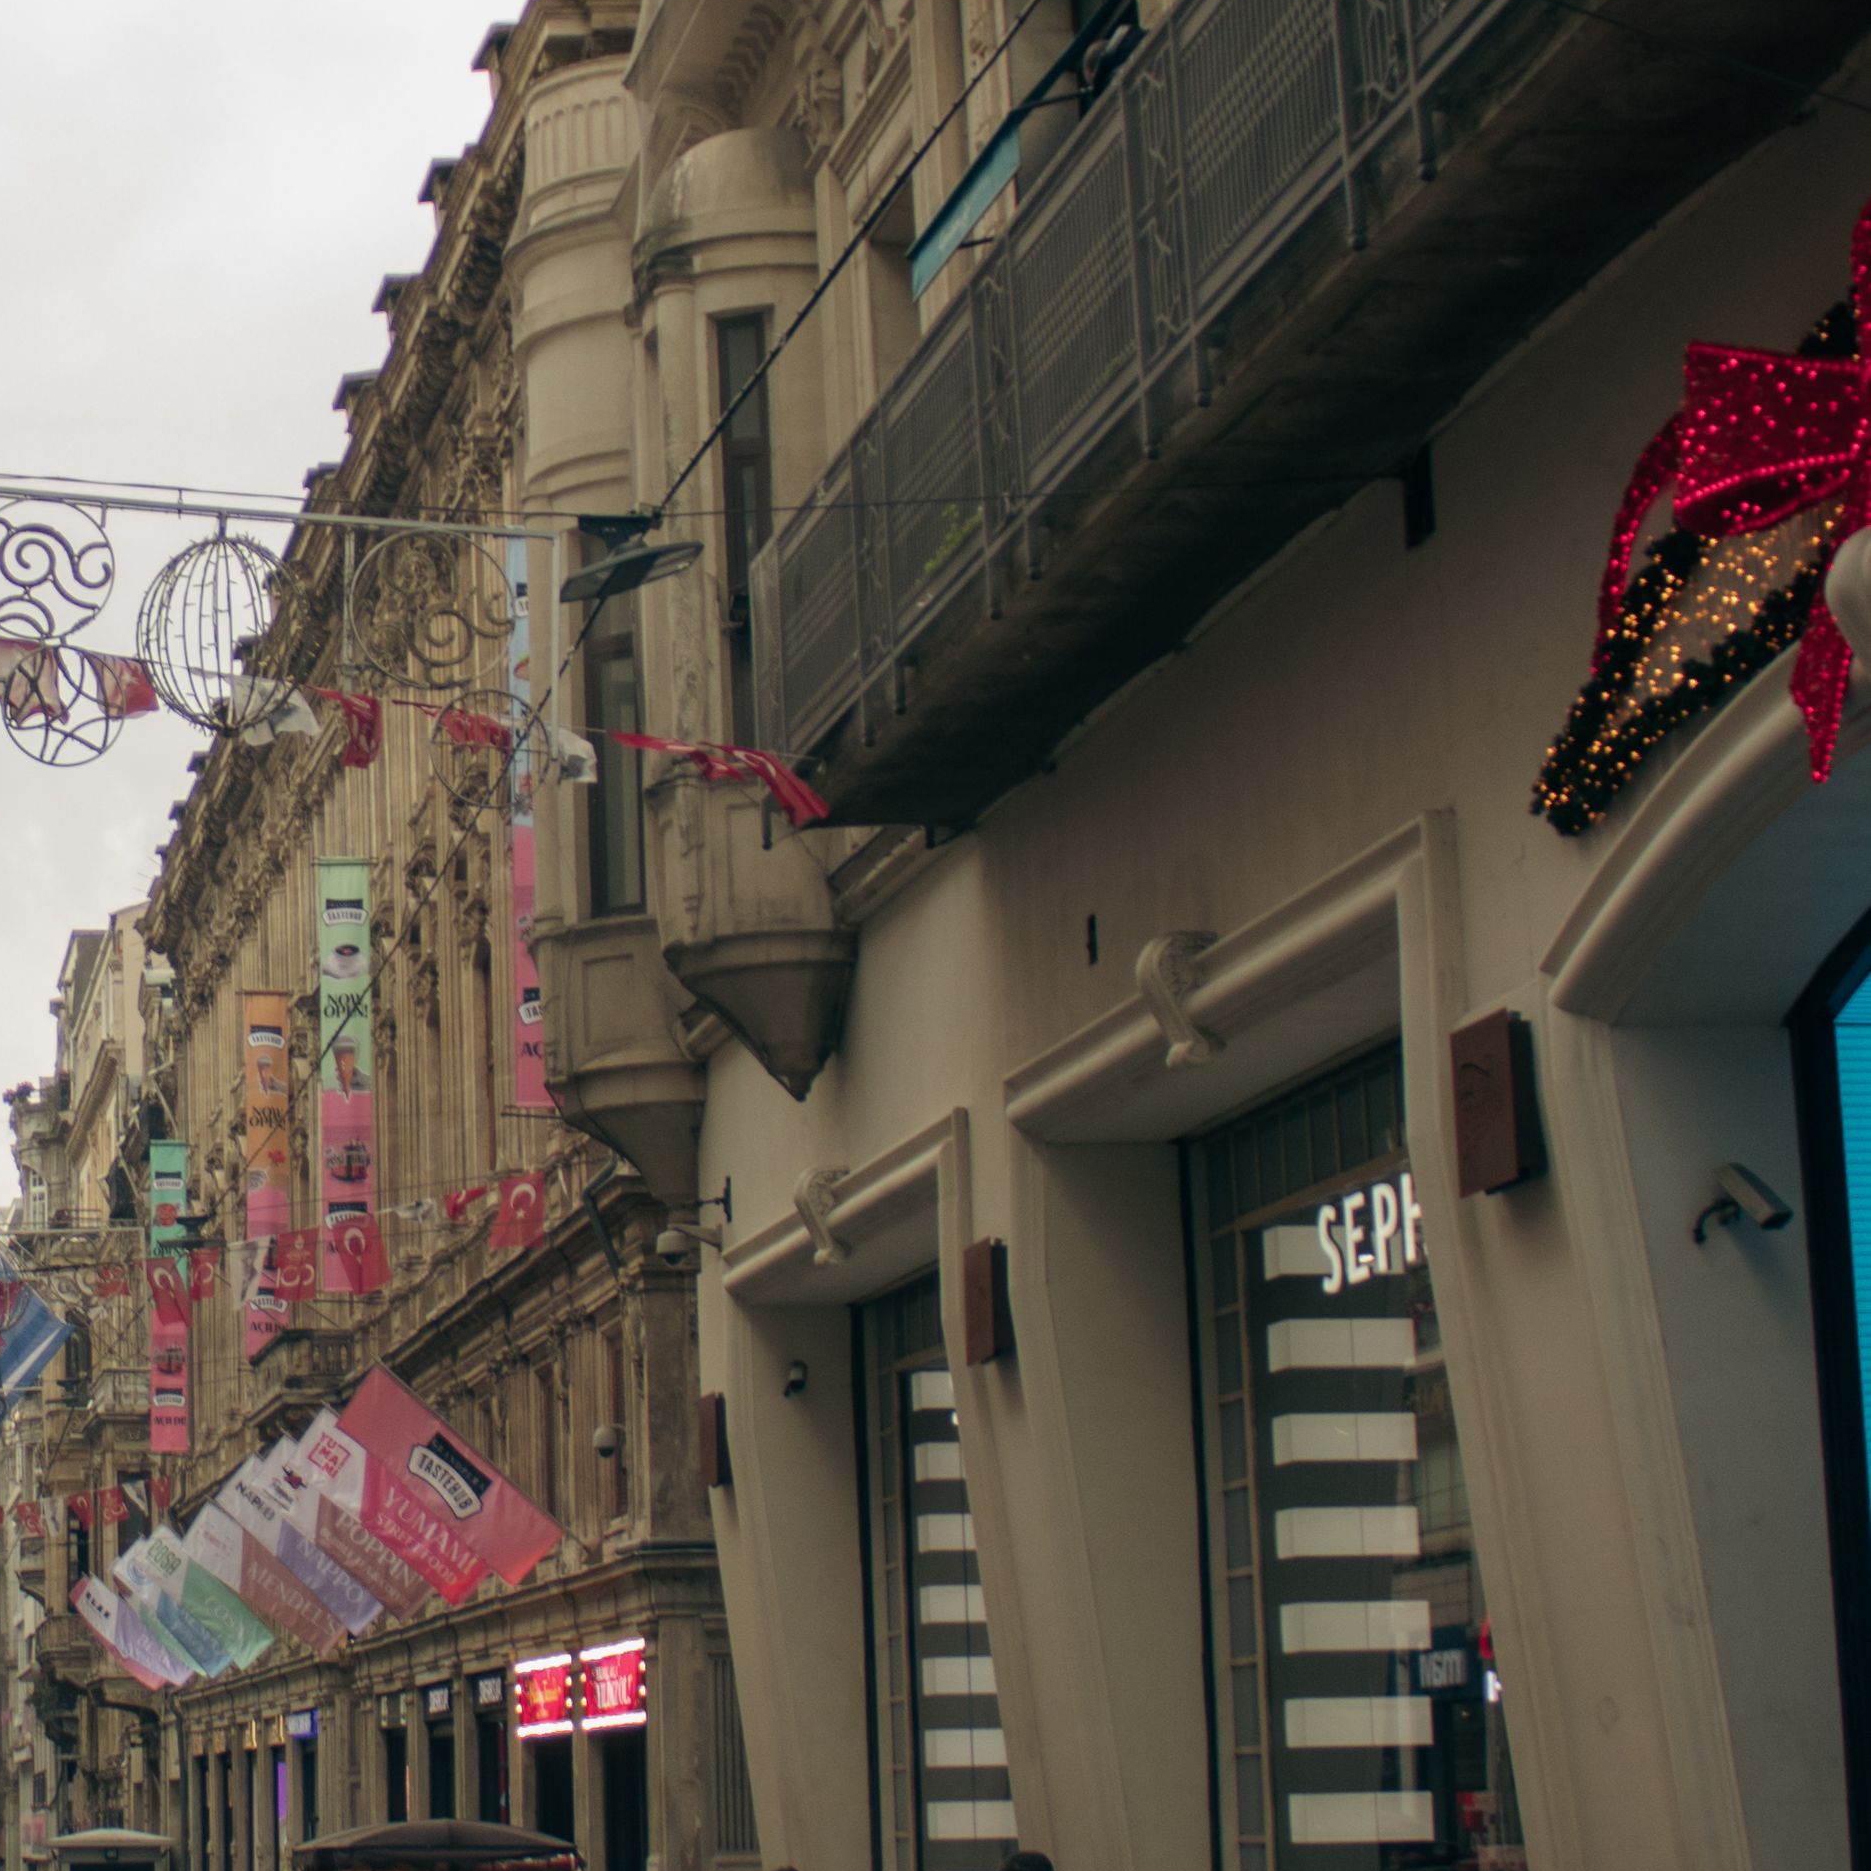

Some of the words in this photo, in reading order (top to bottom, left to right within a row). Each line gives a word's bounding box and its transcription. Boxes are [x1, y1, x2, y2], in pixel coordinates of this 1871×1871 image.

[327, 993, 361, 1006] NOW
[252, 1106, 281, 1117] NOW
[418, 1452, 473, 1510] TASTEHUB
[377, 1512, 421, 1553] STREET
[420, 1548, 458, 1585] FOOD
[382, 1486, 479, 1575] YUMAMI
[296, 1537, 365, 1603] NAPPO
